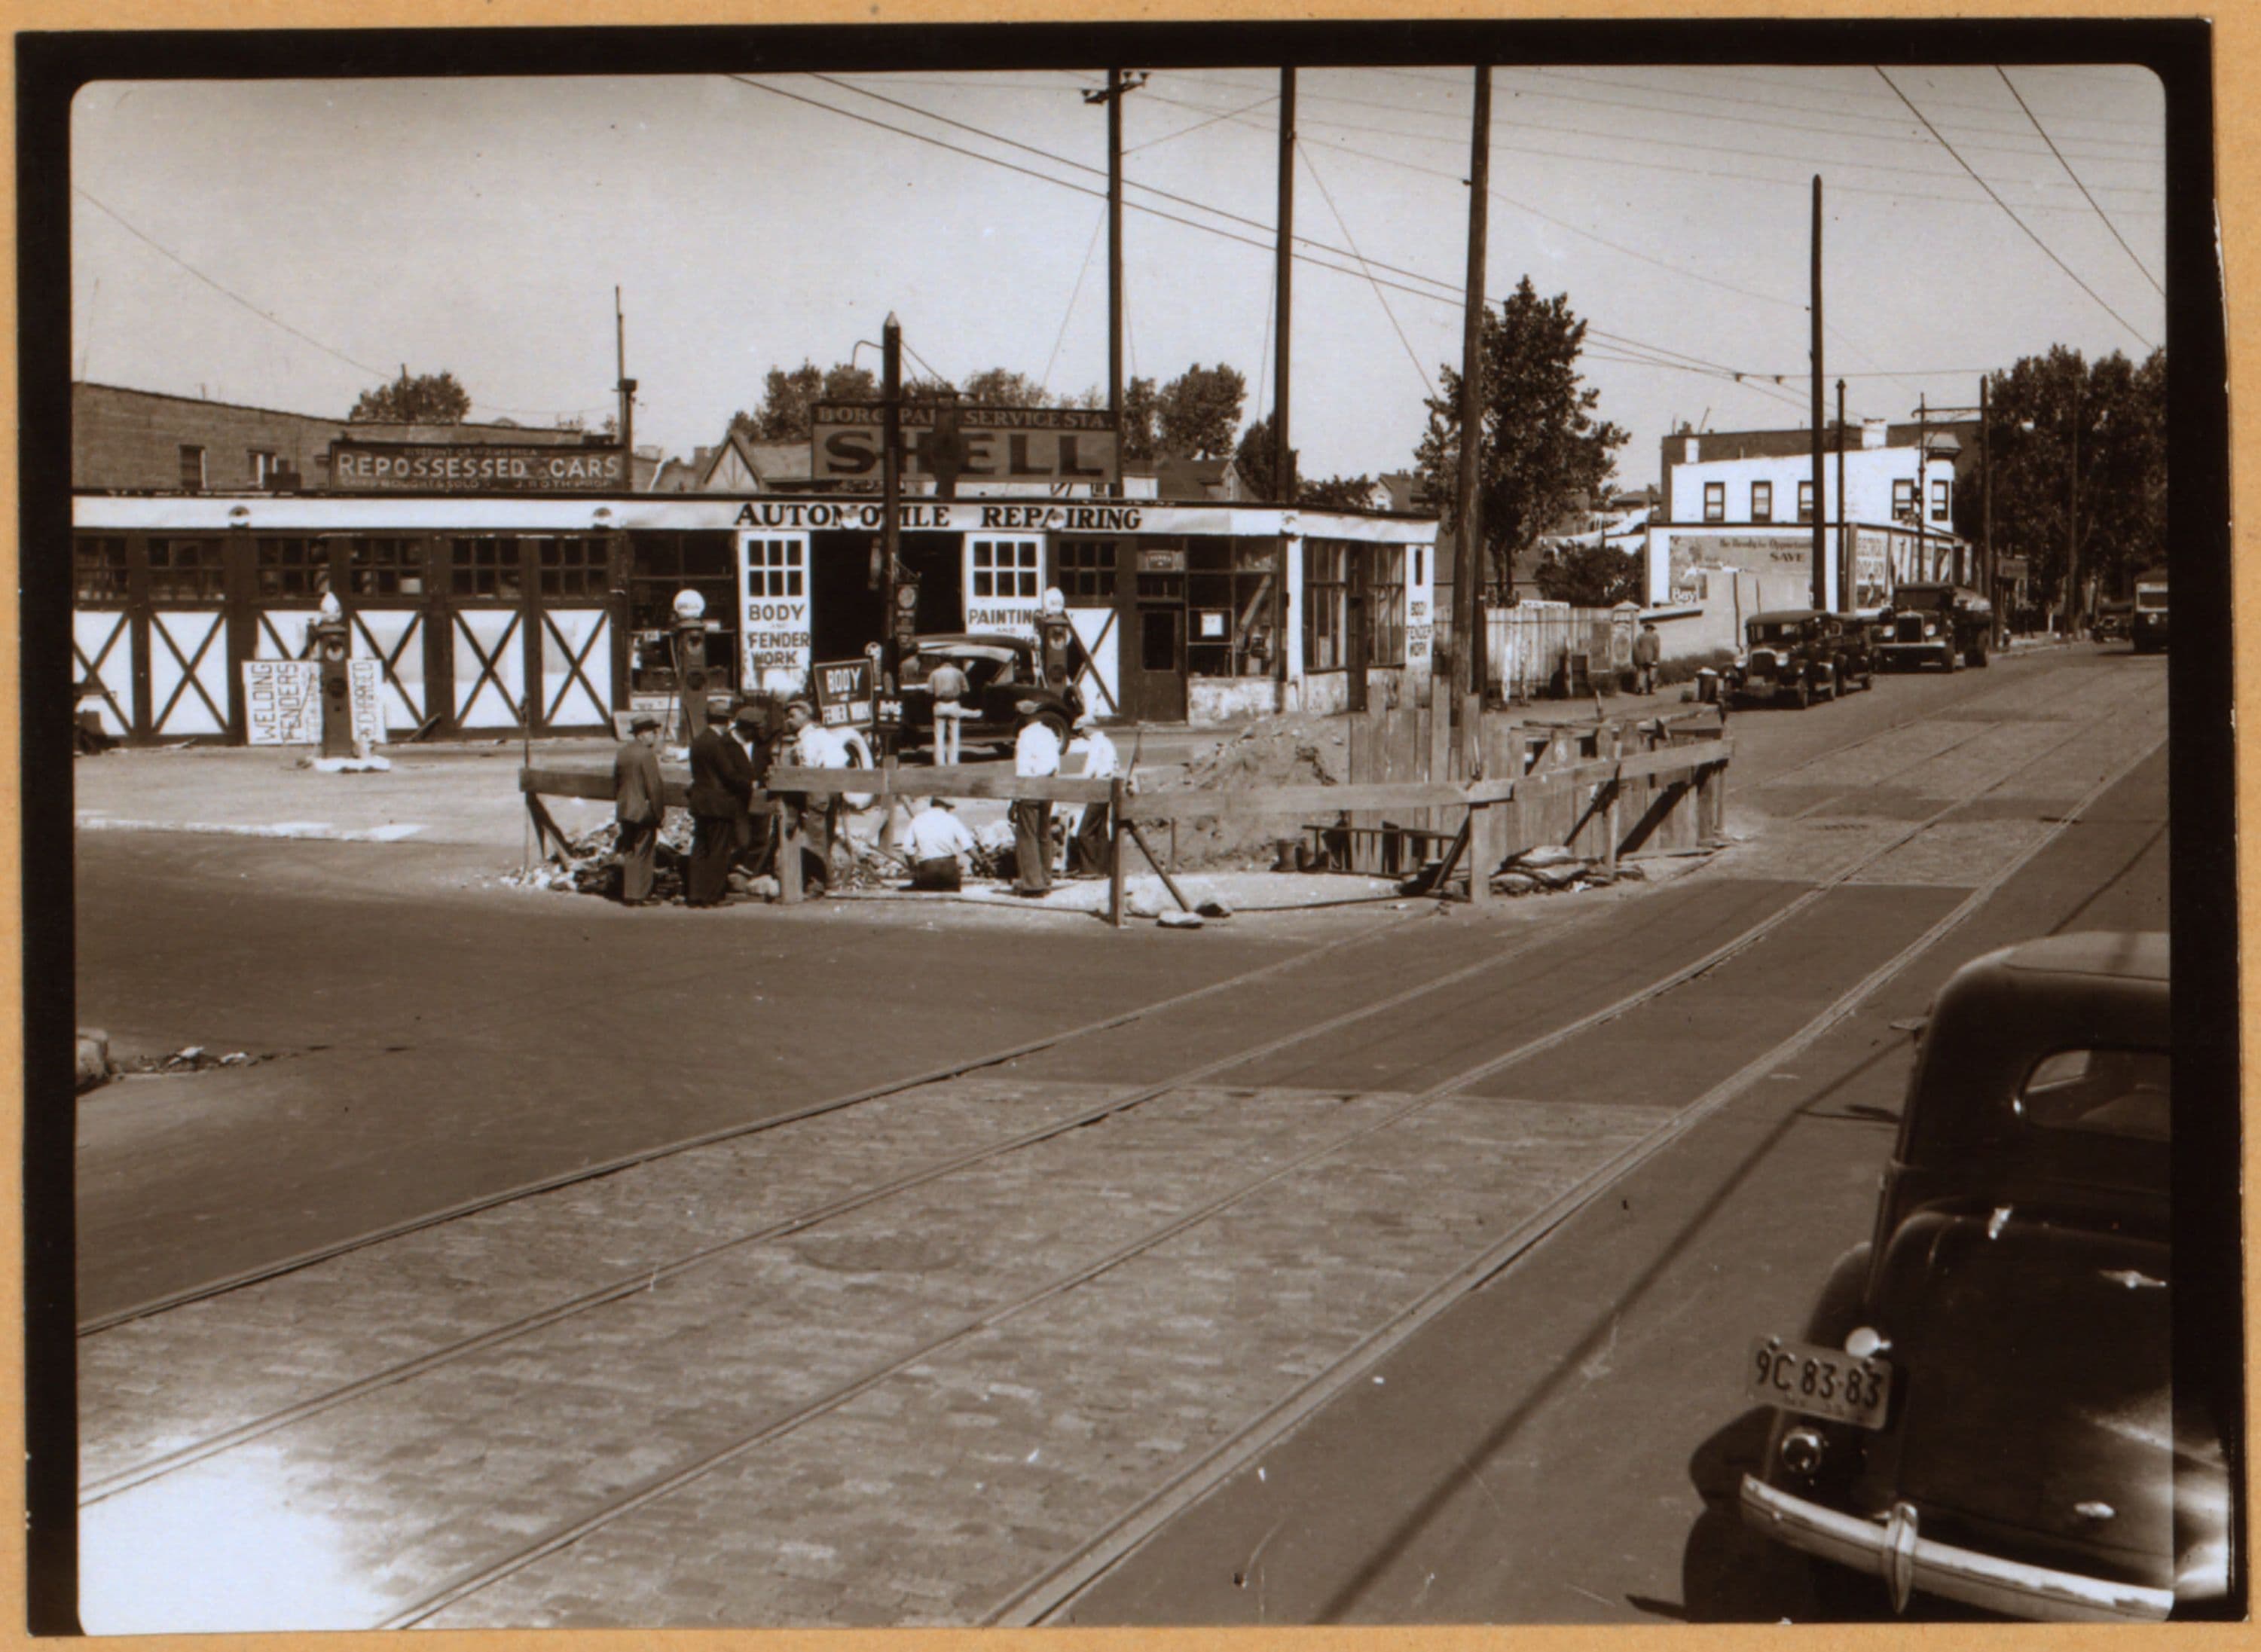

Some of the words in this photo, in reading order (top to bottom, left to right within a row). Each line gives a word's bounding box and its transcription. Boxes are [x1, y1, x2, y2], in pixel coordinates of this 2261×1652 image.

[964, 410, 1060, 427] SERVICE
[825, 429, 1105, 477] SHELL
[338, 453, 526, 479] REPOSSESSED
[549, 453, 619, 478] CARS
[733, 502, 951, 527] AUTOOILE
[1769, 551, 1806, 563] SAVE
[748, 604, 805, 621] BODY
[747, 631, 811, 649] FENDER
[751, 651, 798, 665] WORK
[825, 667, 863, 694] BODY
[250, 663, 279, 741] WELDING
[277, 663, 302, 740] FENDERS
[1756, 1349, 1795, 1391] 9C
